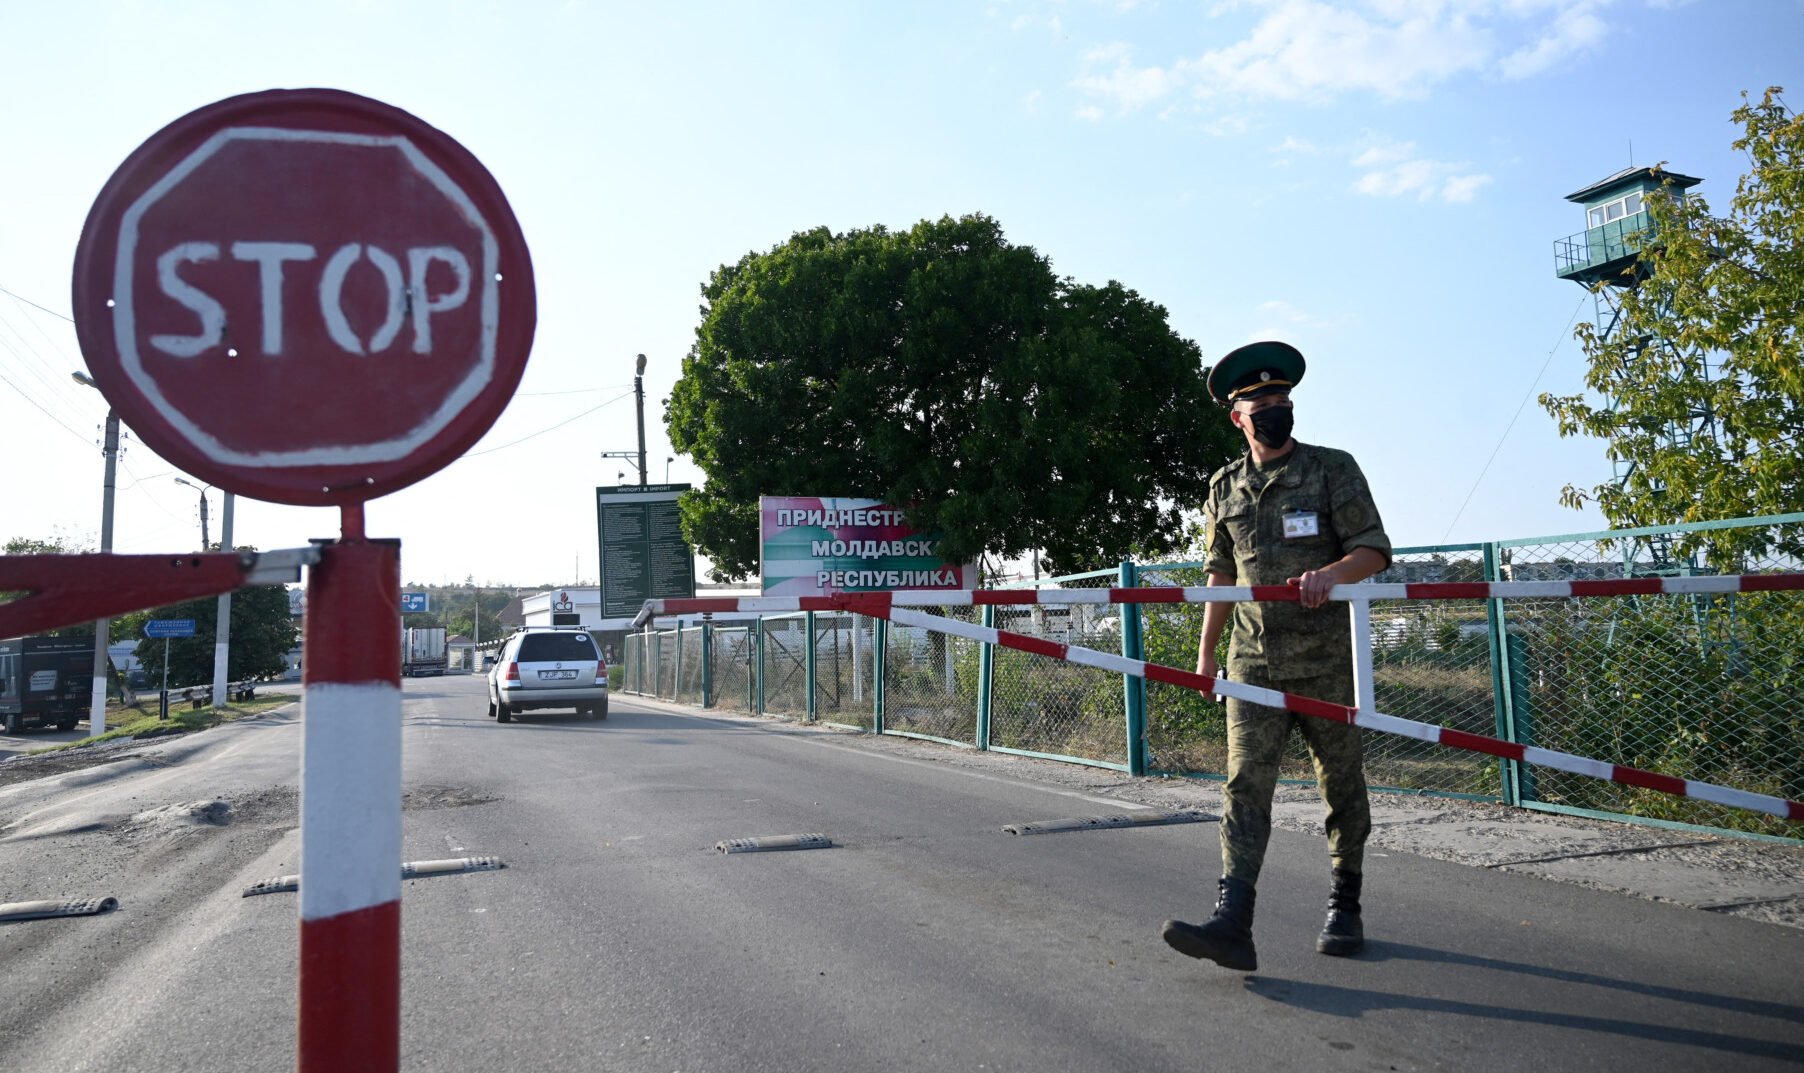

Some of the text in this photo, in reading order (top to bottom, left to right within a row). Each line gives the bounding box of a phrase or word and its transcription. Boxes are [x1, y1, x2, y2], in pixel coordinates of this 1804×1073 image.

[149, 241, 471, 357] STOP
[776, 509, 904, 528] ПРИДНЕСТР
[811, 540, 941, 559] МОЛДАВСК
[817, 570, 957, 588] РЕСПУБЛИКА
